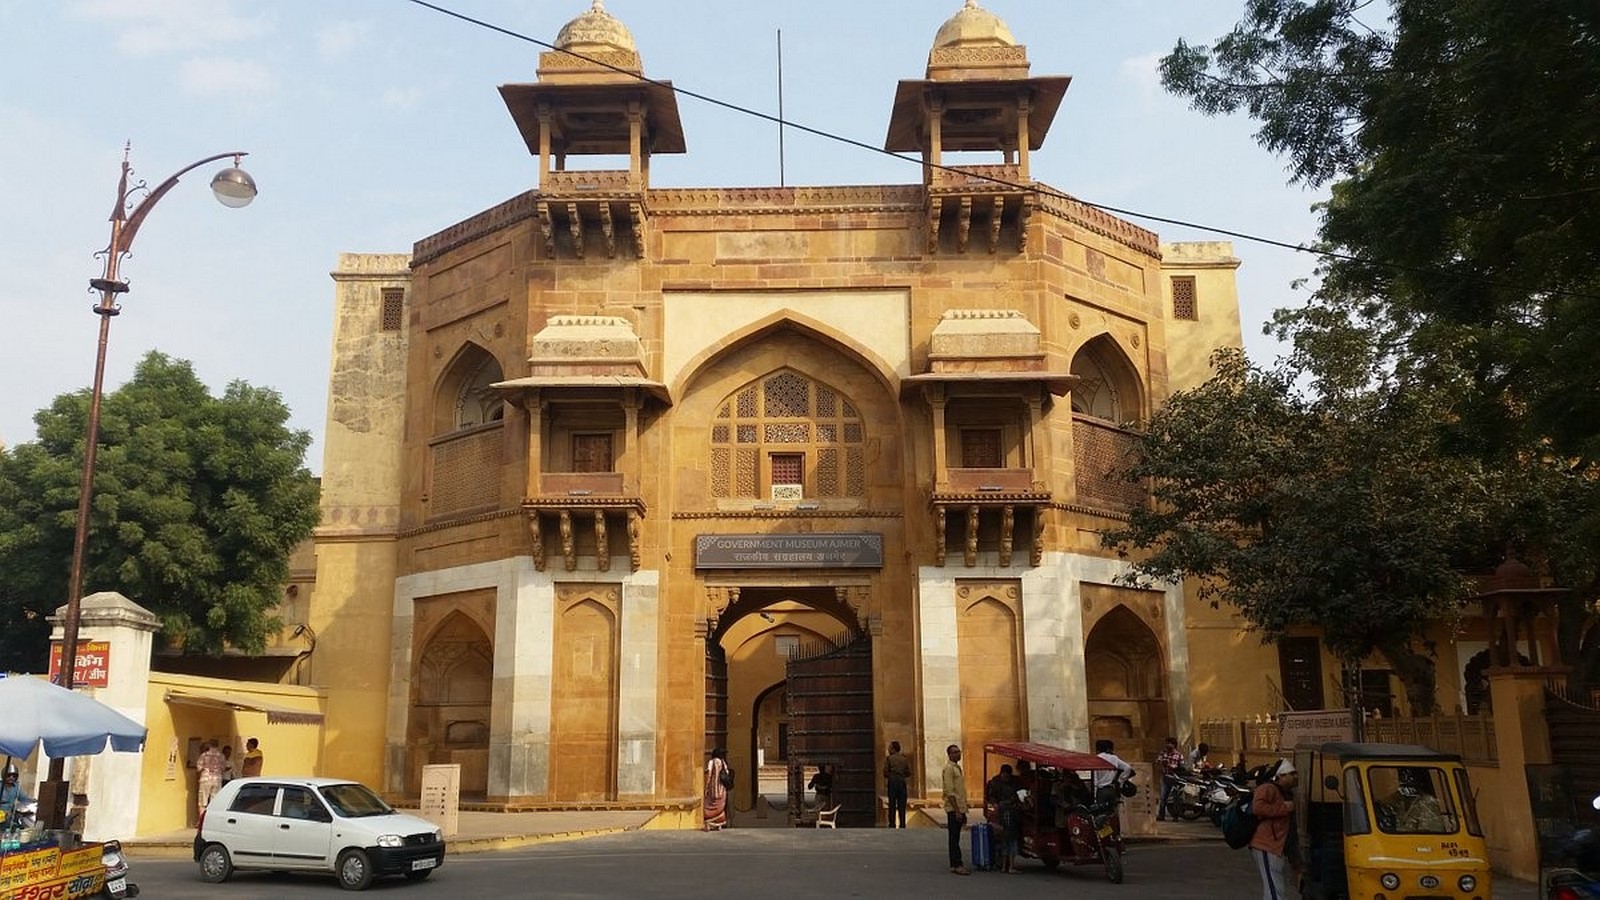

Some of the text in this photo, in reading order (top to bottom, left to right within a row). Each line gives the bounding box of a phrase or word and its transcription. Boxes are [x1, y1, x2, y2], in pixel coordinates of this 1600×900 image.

[717, 538, 860, 549] GOVERNMENT MUSEUM AJMER
